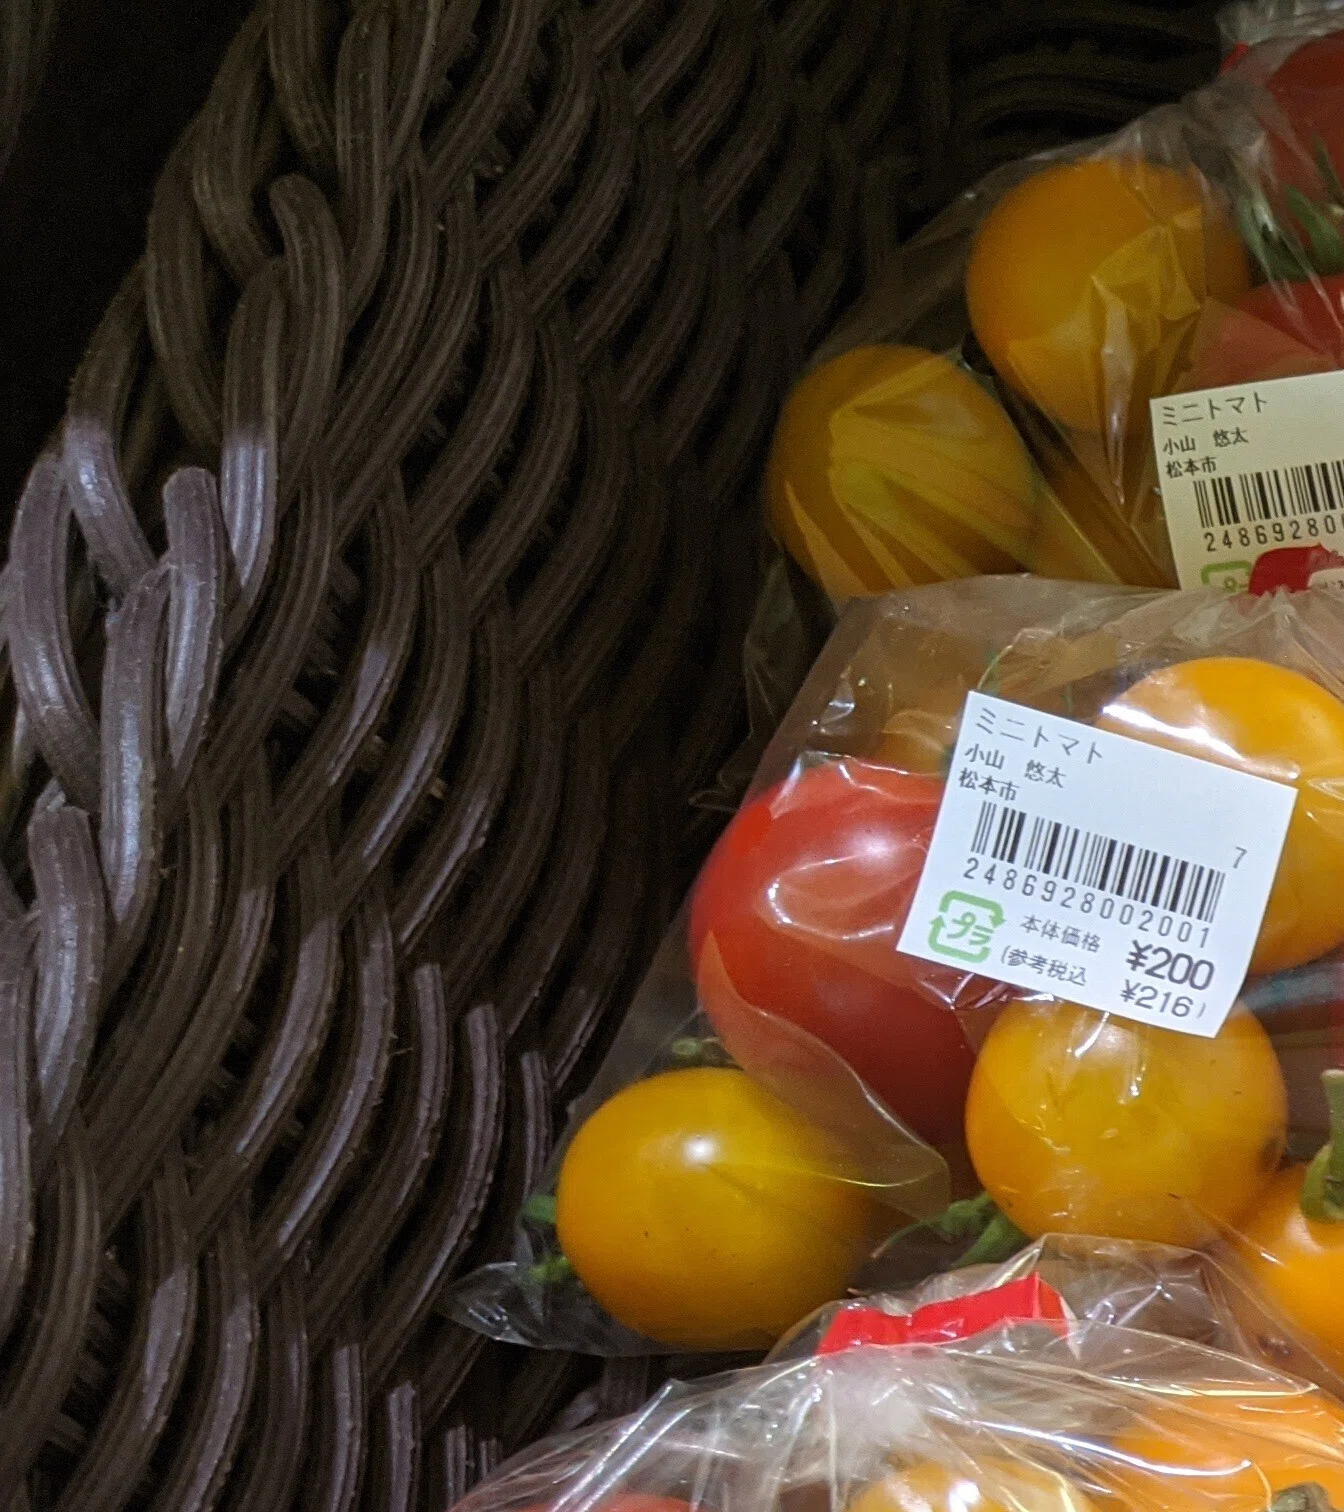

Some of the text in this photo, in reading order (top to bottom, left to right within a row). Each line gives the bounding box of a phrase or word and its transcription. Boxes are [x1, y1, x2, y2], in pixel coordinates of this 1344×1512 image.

[1161, 391, 1269, 427] ミニトマト
[1162, 426, 1250, 456] 小山 悠太
[1164, 455, 1218, 479] 松本市
[974, 705, 1104, 766] ミニトマト
[964, 742, 1067, 790] 小山 悠太
[957, 767, 1020, 802] 松本市
[1233, 846, 1249, 870] 7
[963, 857, 1213, 950] 2486928002001
[1019, 914, 1216, 992] 本体価格 ¥200
